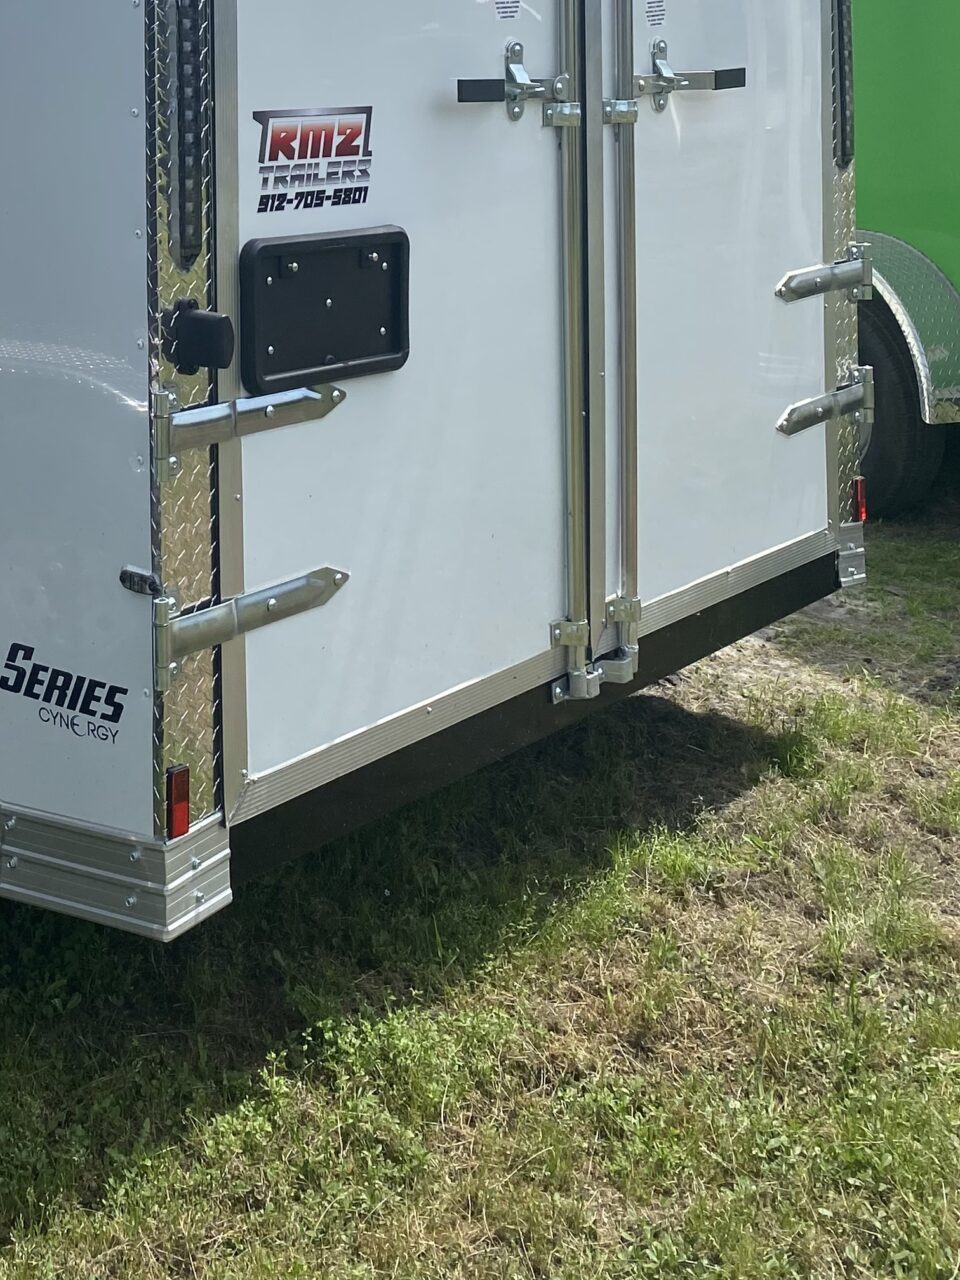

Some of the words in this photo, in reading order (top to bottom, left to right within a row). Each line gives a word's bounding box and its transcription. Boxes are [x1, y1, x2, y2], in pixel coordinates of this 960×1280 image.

[259, 159, 371, 190] TRAILERS
[257, 186, 368, 213] 912-705-5801
[38, 707, 119, 744] CYNERGY
